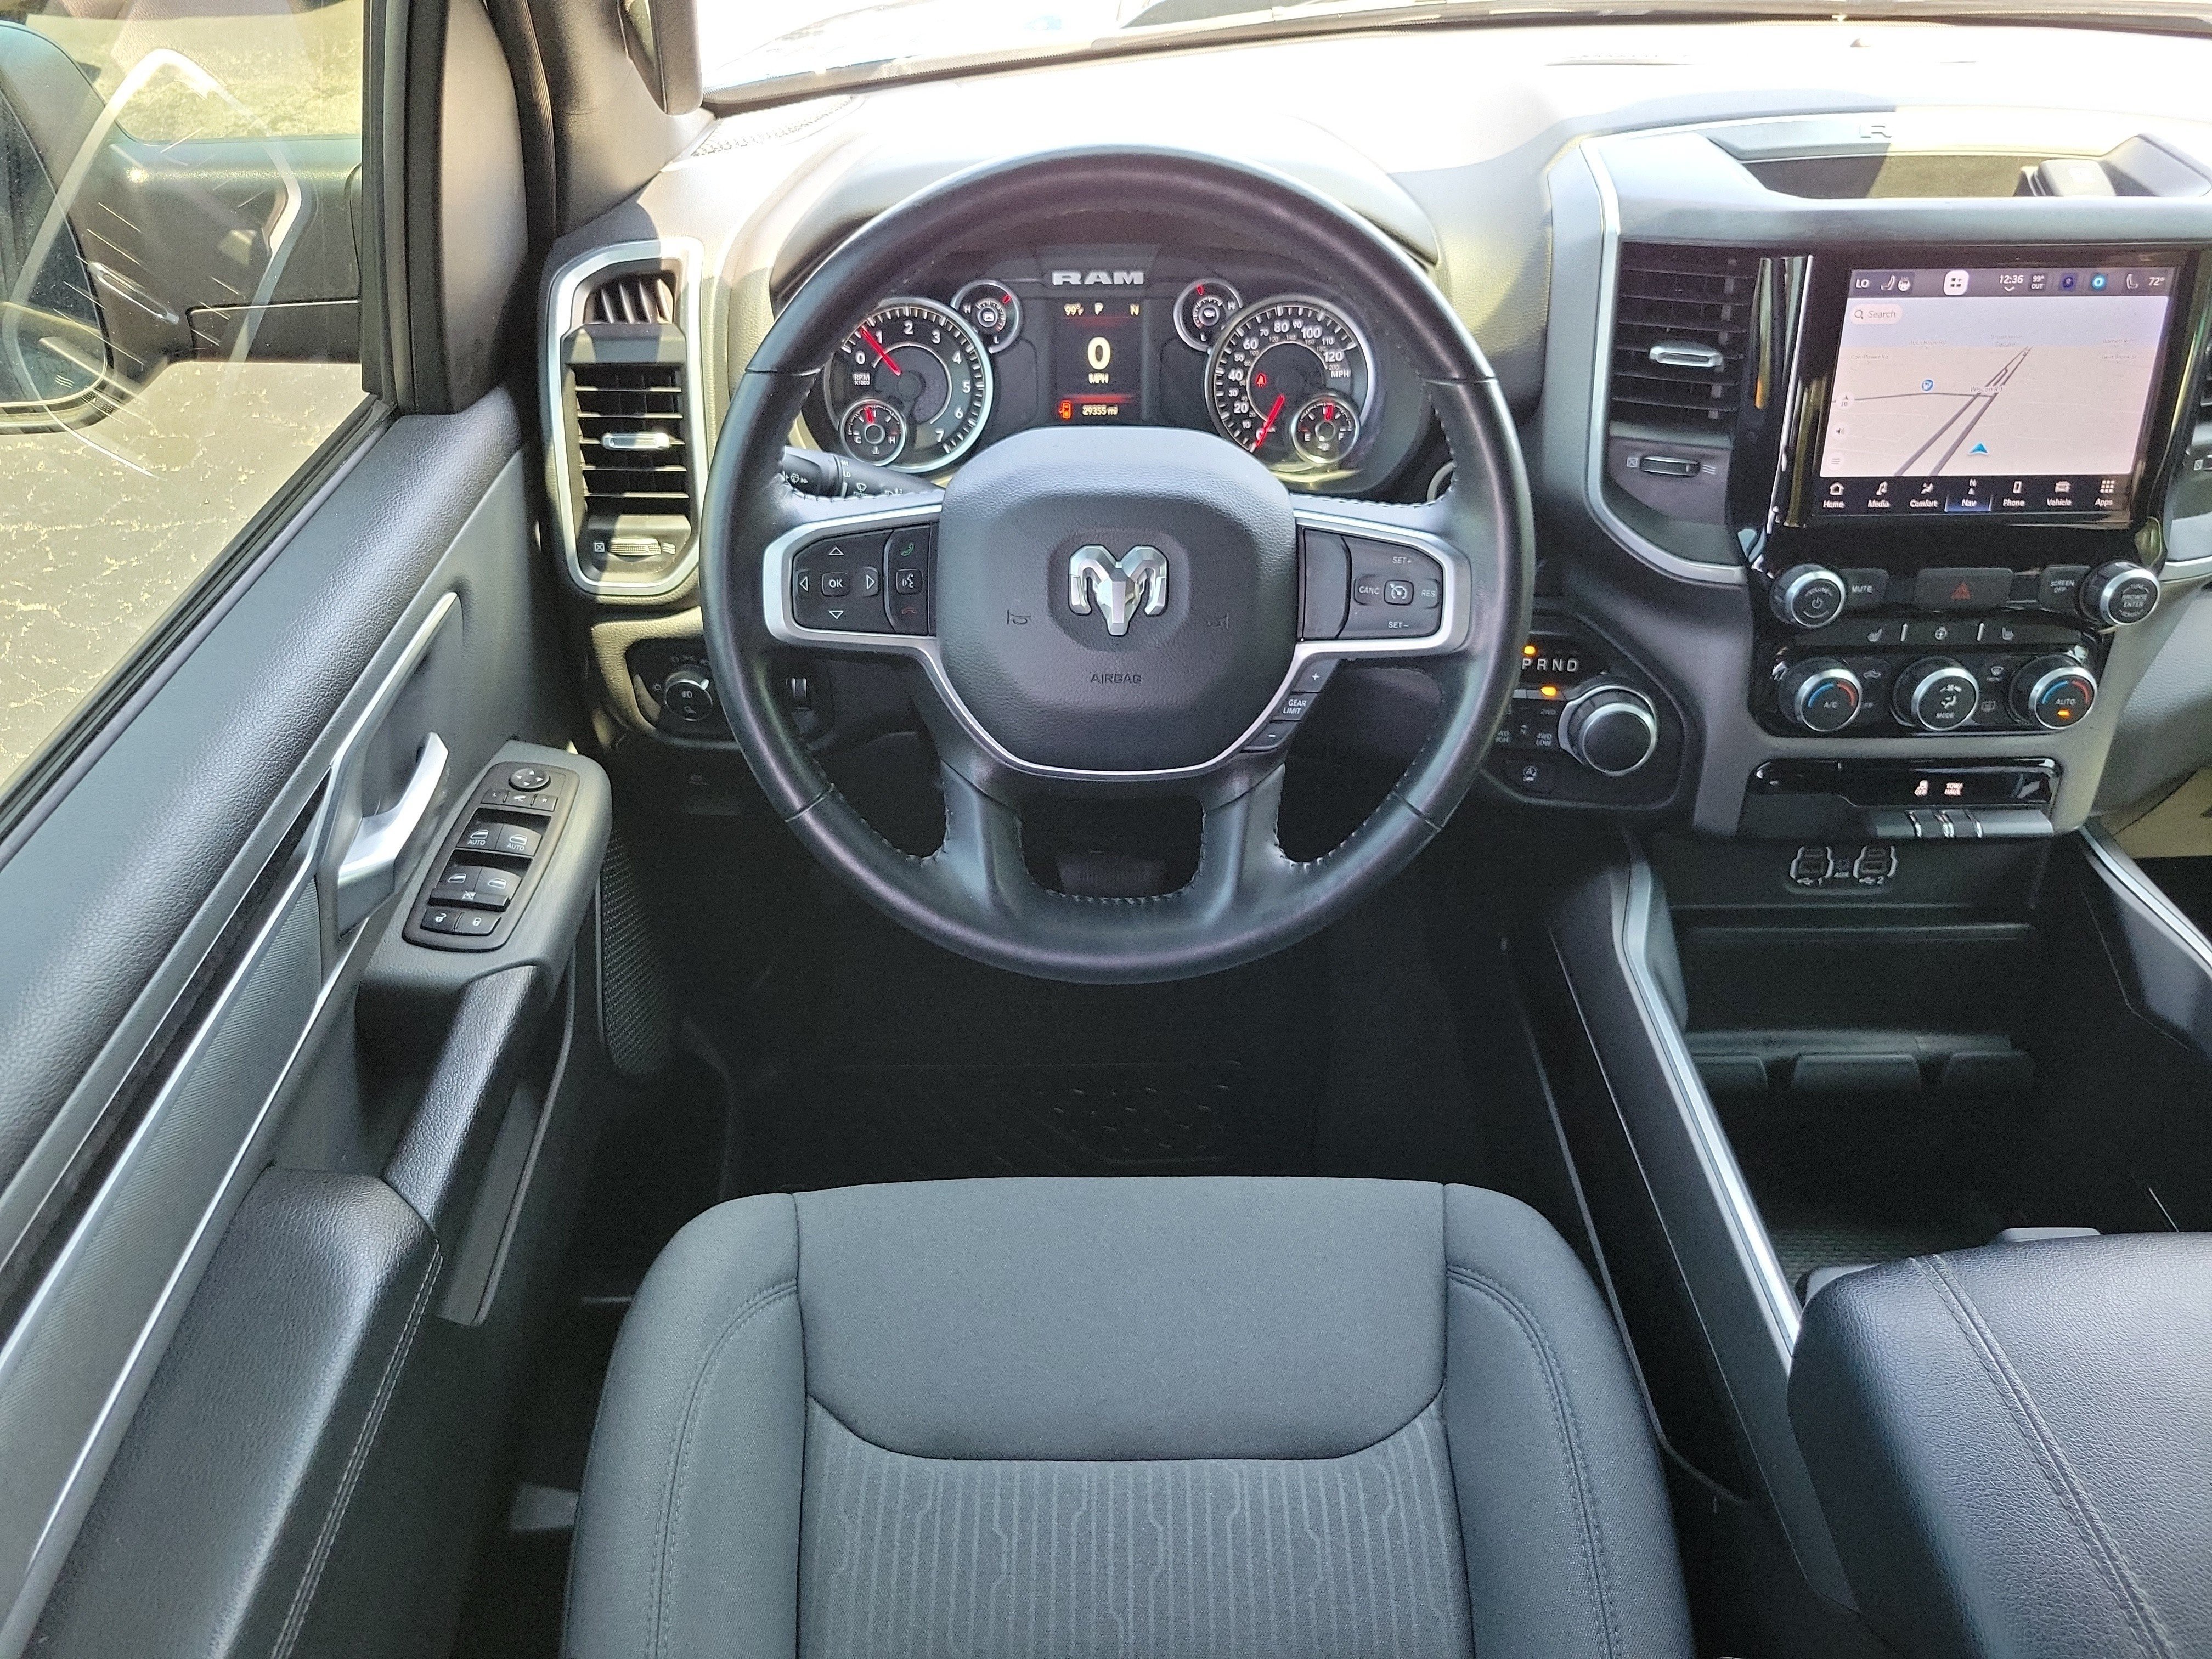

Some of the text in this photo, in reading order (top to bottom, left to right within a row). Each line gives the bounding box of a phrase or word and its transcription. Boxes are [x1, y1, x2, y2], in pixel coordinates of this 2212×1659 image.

[1052, 271, 1144, 285] RAM
[1999, 275, 2024, 284] 12:36
[2148, 276, 2165, 286] 72°
[1856, 278, 1870, 289] LO
[963, 304, 971, 314] H
[1094, 303, 1103, 315] P
[1130, 303, 1139, 315] N
[1228, 301, 1235, 310] H
[1867, 310, 1895, 318] Search
[904, 320, 913, 335] 2
[1274, 320, 1289, 333] 80
[1293, 320, 1304, 329] 90
[932, 330, 941, 343] 3
[1260, 328, 1269, 336] 70
[1301, 325, 1322, 338] 100
[876, 330, 882, 345] 1
[1322, 336, 1335, 345] 110
[1243, 337, 1259, 350] 60
[856, 351, 865, 364] 0
[952, 352, 961, 364] 4
[1088, 337, 1110, 370] 0
[1234, 352, 1245, 362] 50
[1323, 349, 1344, 362] 120
[853, 373, 870, 381] RPM
[1088, 373, 1109, 384] MPH
[1228, 368, 1244, 381] 40
[1330, 369, 1351, 378] MPH
[962, 381, 970, 393] 5
[1228, 387, 1239, 397] 30
[1082, 405, 1118, 415] 29355 mi
[1234, 400, 1249, 413] 20
[955, 408, 963, 419] 6
[1242, 420, 1251, 428] 10
[888, 436, 895, 444] H
[936, 430, 945, 442] 7
[1305, 432, 1311, 441] E
[1339, 432, 1344, 441] F
[1823, 500, 1845, 508] Home
[1868, 499, 1891, 508] Media
[1910, 498, 1938, 507] Comfort
[1961, 498, 1977, 507] Nav
[2002, 498, 2025, 506] Phone
[2046, 498, 2072, 506] Vehicle
[2095, 498, 2112, 507] Apps
[829, 579, 843, 588] OK
[1359, 586, 1380, 595] CANC
[1852, 585, 1872, 593] MUTE
[1522, 658, 1579, 673] P R N D
[1090, 673, 1142, 685] AIRBAG
[1288, 699, 1307, 707] GEAR
[1818, 877, 1823, 885] 1
[1876, 876, 1884, 885] 2
